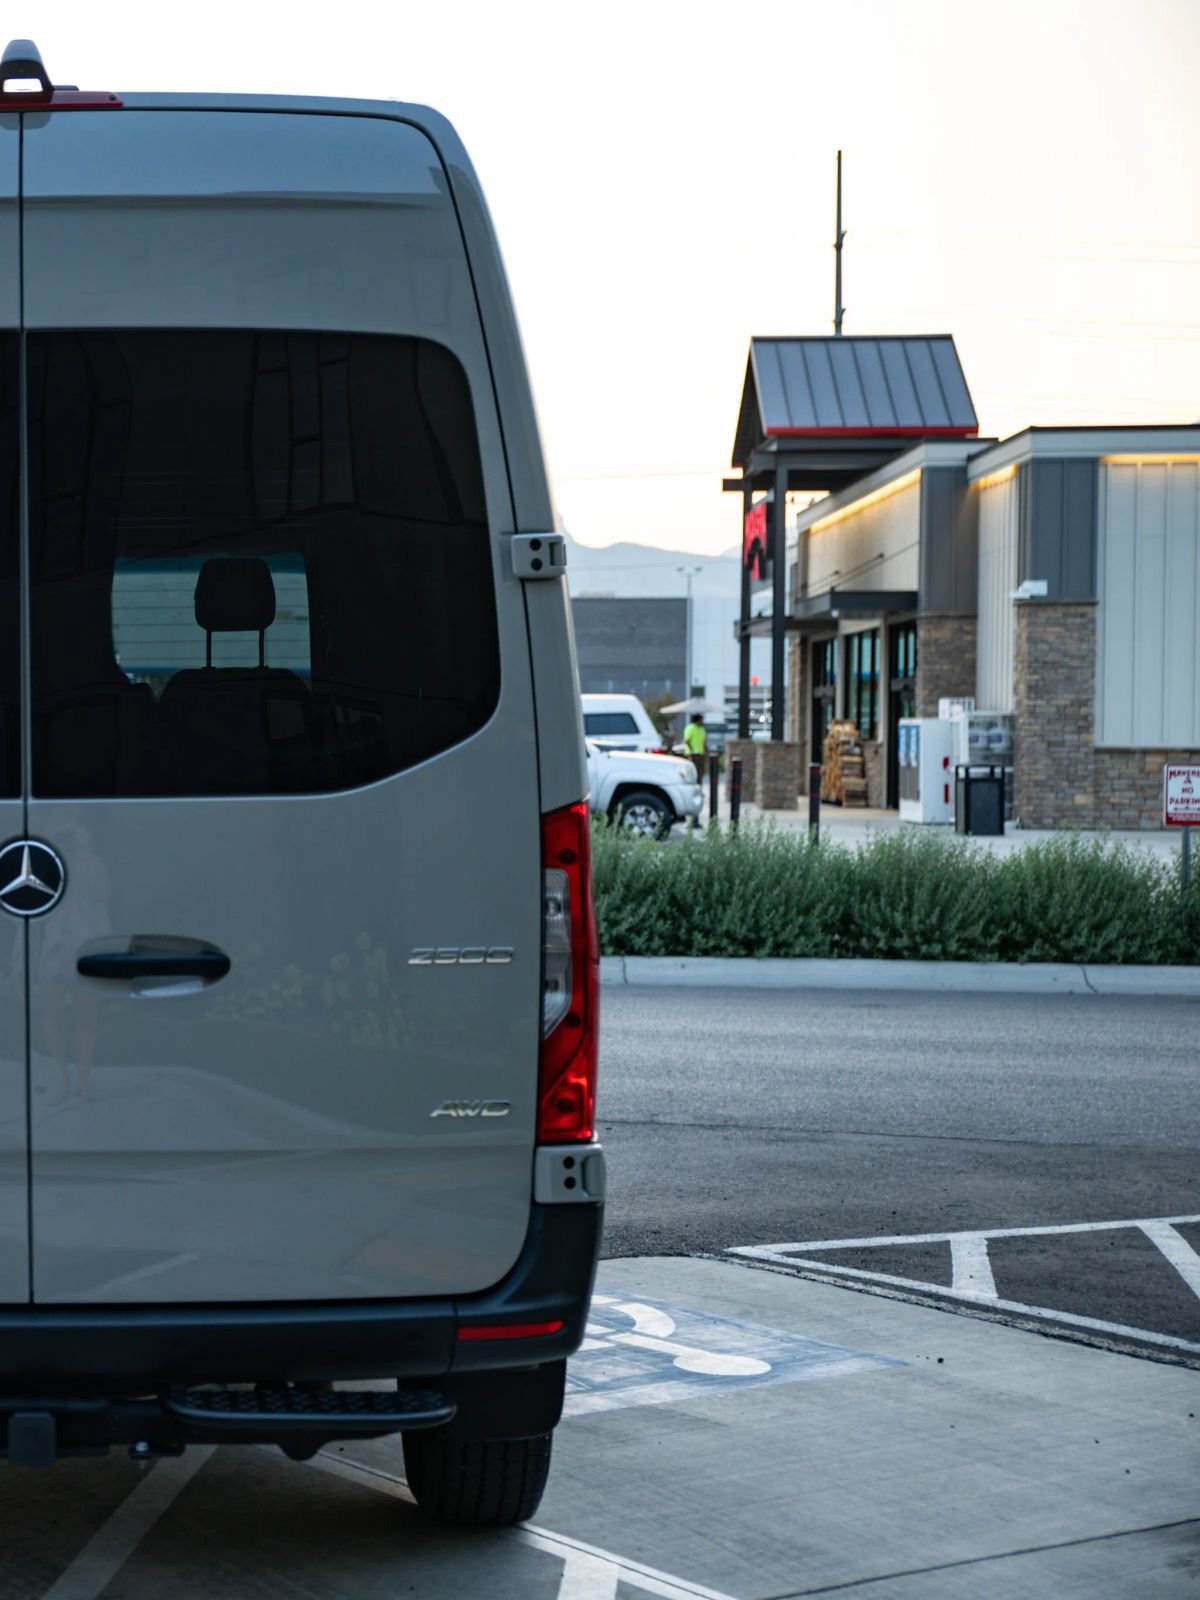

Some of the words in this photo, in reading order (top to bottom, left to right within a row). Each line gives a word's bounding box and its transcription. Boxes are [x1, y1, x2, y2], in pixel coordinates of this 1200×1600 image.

[1169, 769, 1200, 780] MAVERI
[1181, 786, 1194, 795] NO
[1169, 797, 1200, 805] PARKIN
[408, 946, 514, 964] 2500
[430, 1099, 512, 1117] AWD
